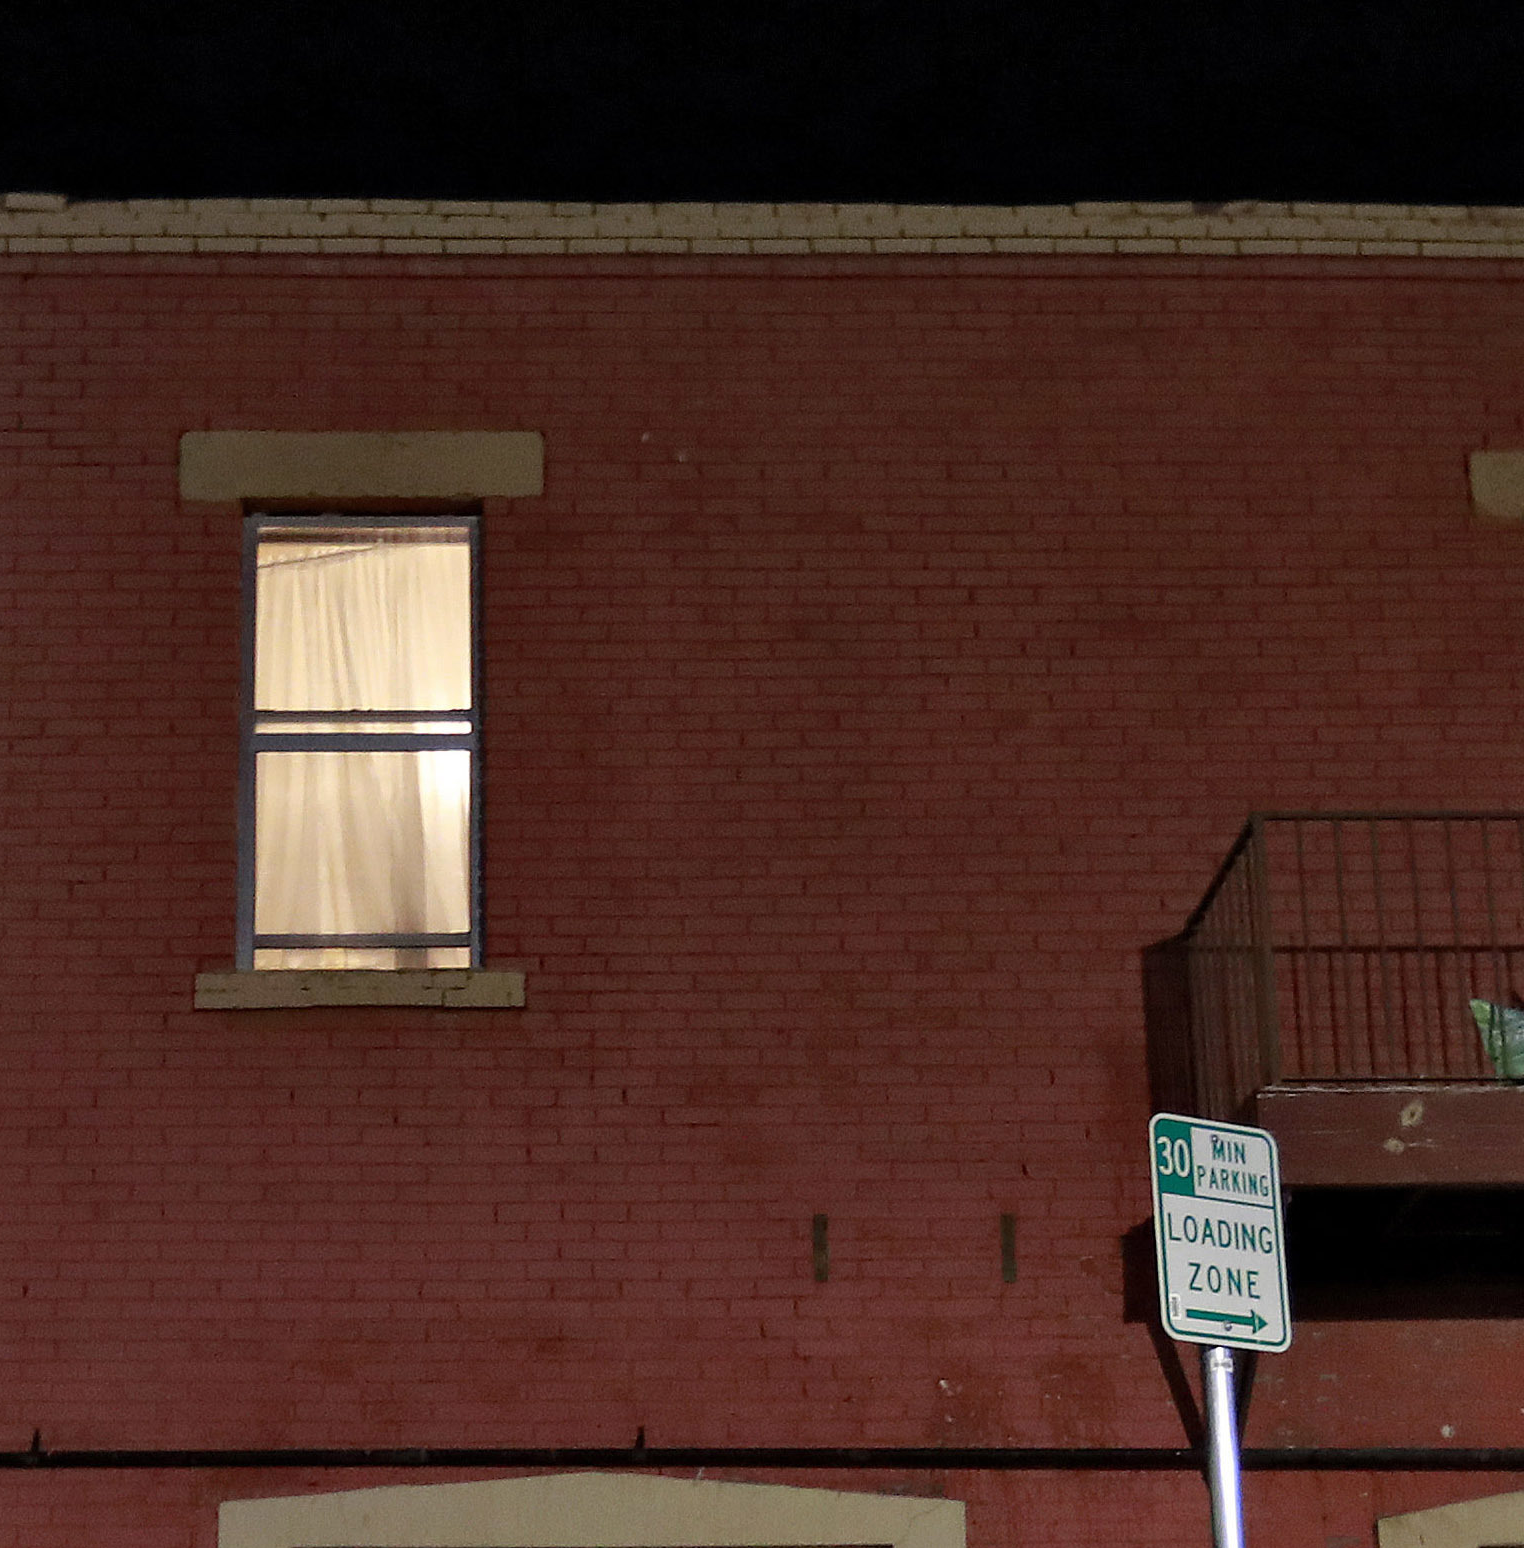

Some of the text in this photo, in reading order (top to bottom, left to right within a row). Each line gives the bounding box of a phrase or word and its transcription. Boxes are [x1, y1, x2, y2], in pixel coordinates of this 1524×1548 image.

[1157, 1136, 1191, 1178] 30
[1212, 1140, 1246, 1164] MIN
[1197, 1165, 1269, 1197] PARKING
[1168, 1212, 1273, 1254] LOADING
[1188, 1262, 1261, 1300] ZONE
